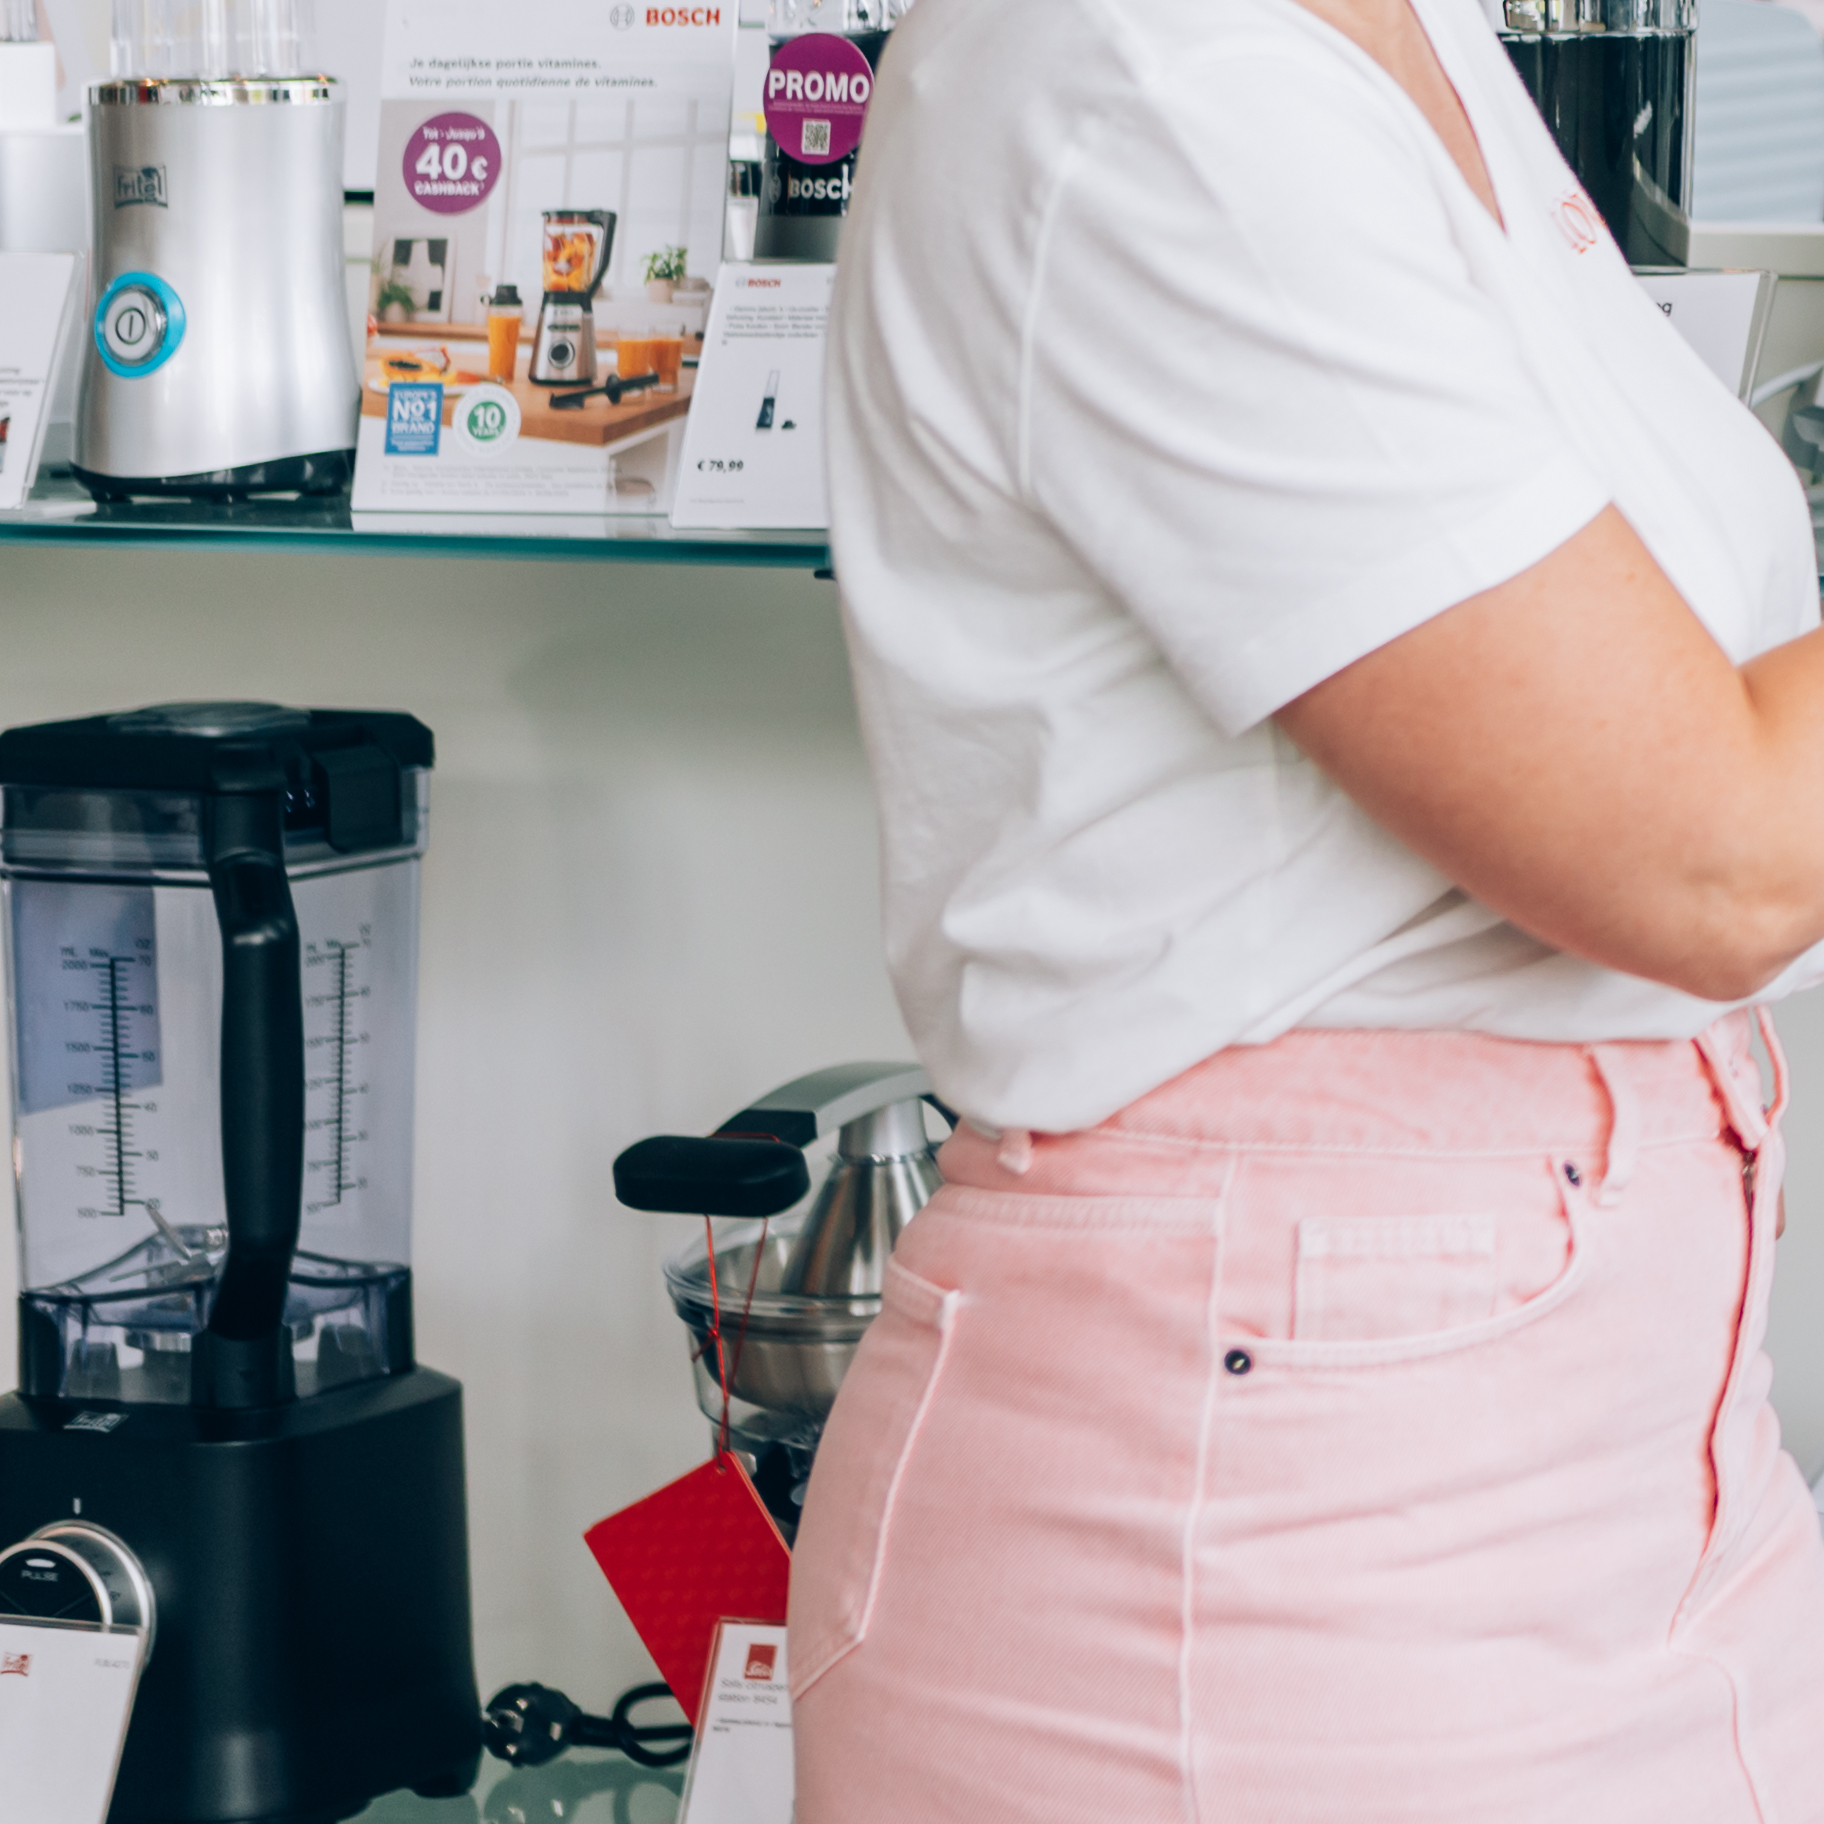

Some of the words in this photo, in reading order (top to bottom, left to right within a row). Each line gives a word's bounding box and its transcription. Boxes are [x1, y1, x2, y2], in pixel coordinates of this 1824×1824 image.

[645, 7, 721, 27] BOSCH
[496, 58, 534, 72] portie
[446, 76, 492, 90] portion
[768, 68, 870, 104] PROMO
[415, 142, 468, 181] 40
[747, 279, 782, 288] BOSCH
[473, 406, 501, 429] 10
[709, 460, 744, 473] 79,99
